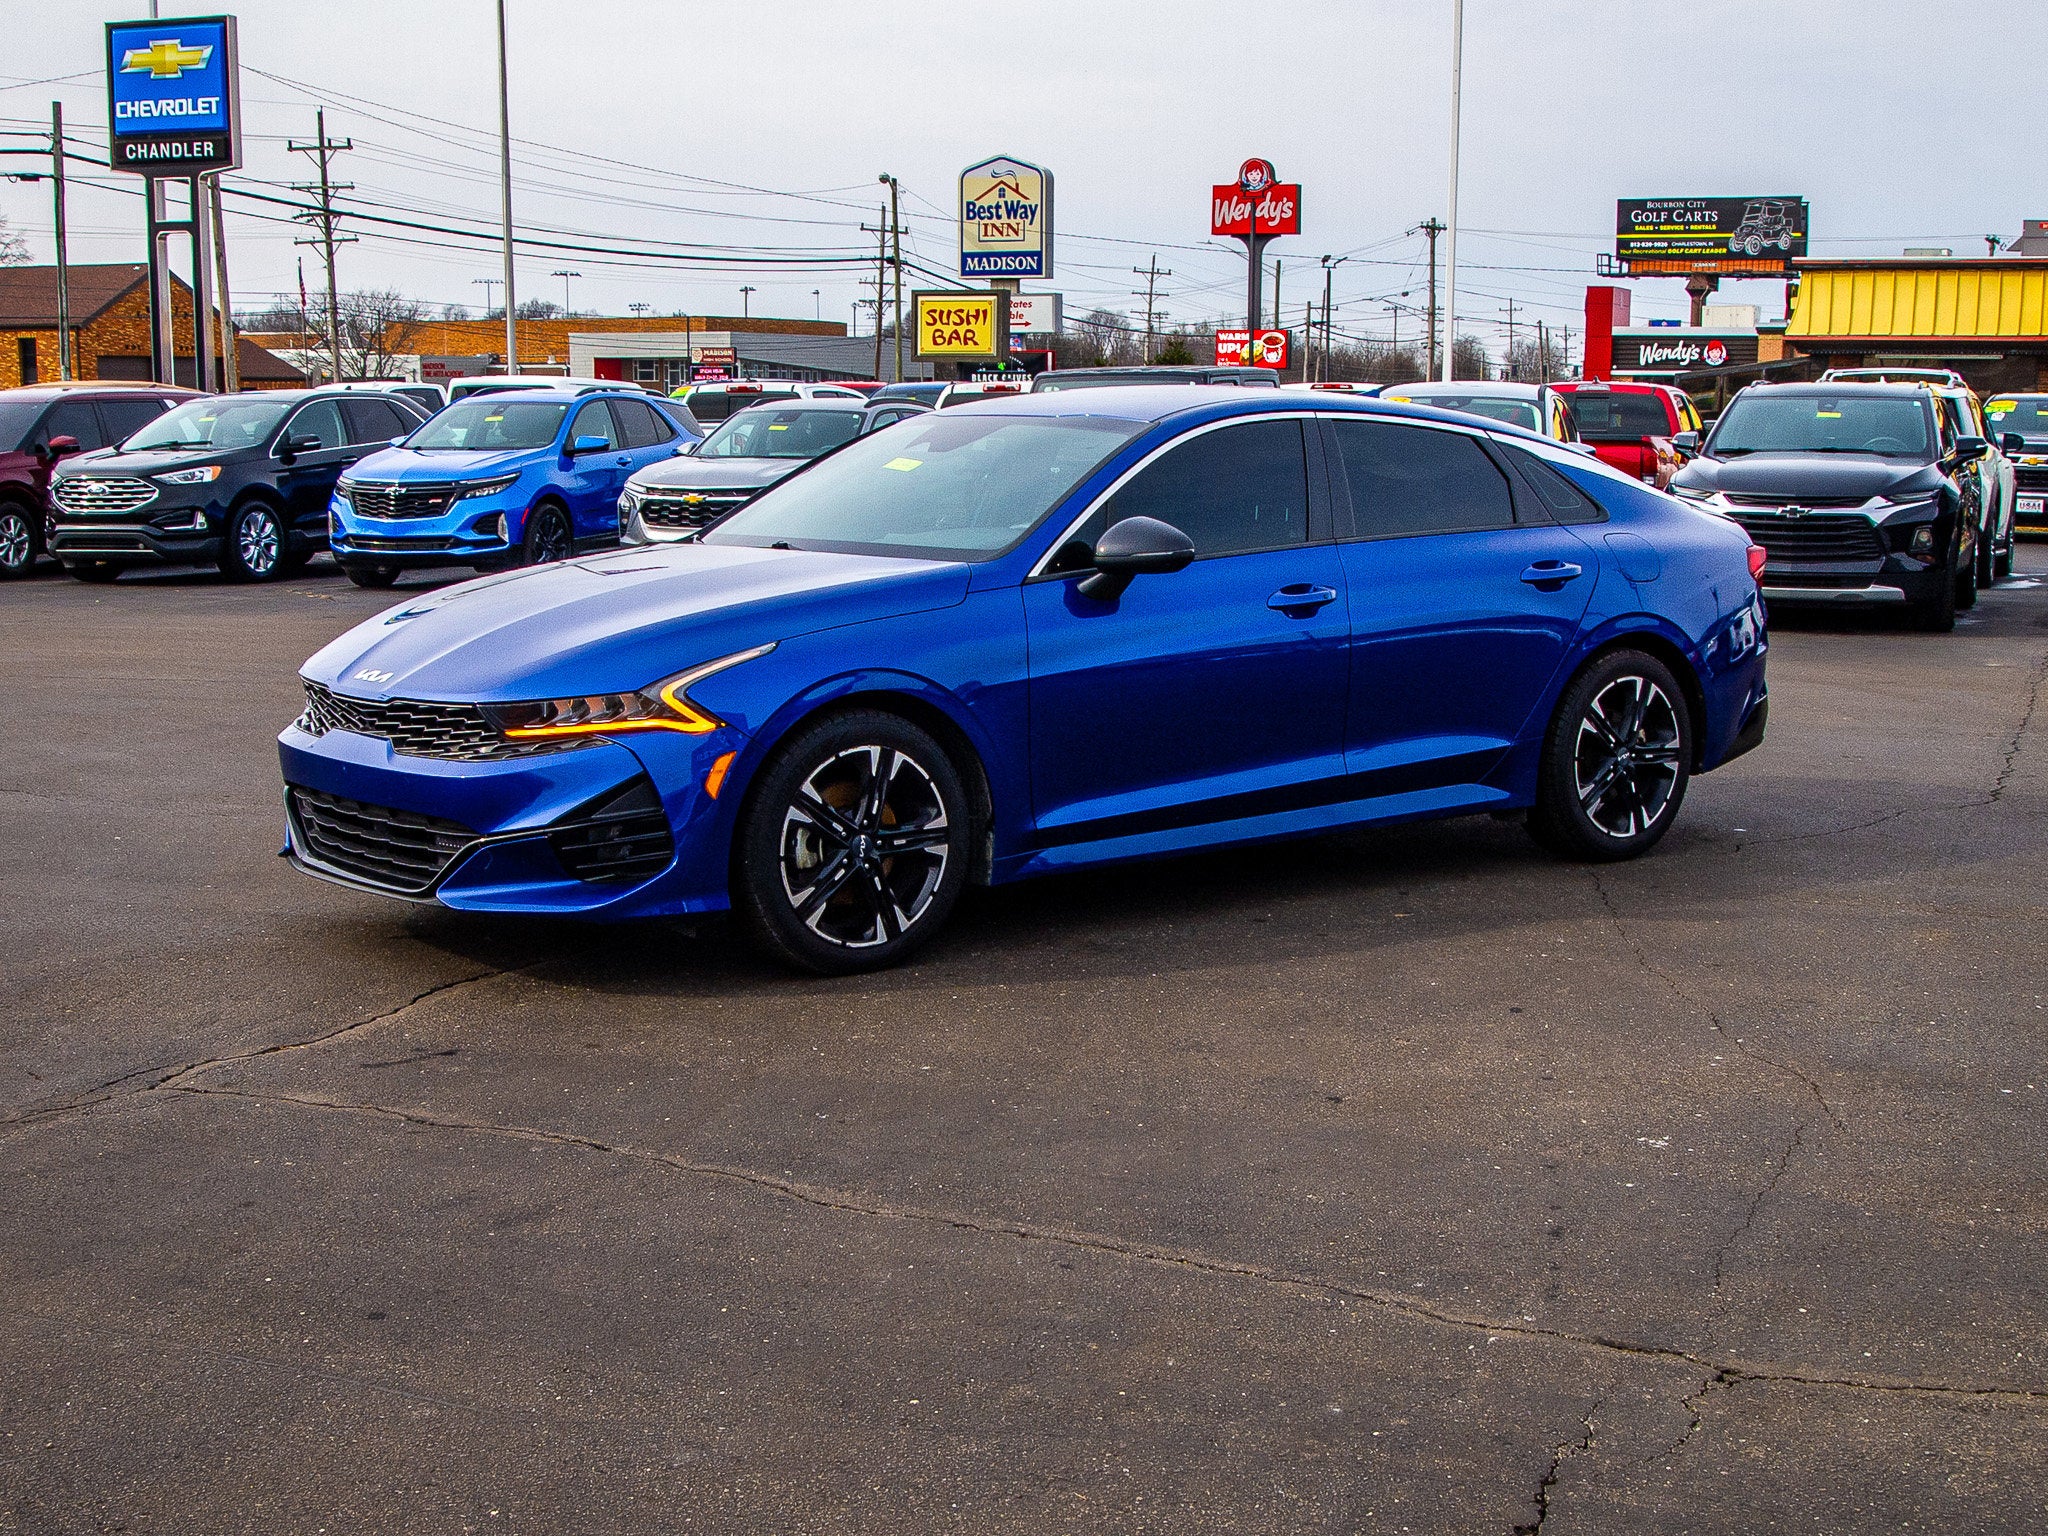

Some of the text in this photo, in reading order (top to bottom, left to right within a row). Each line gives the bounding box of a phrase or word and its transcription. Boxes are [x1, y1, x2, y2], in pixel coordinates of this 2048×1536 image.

[116, 97, 220, 118] CHEVROLET
[126, 141, 214, 159] CHANDLER
[965, 200, 1039, 226] Best Way
[1686, 200, 1707, 209] CITY
[1630, 209, 1718, 222] GOLF CARTS
[982, 222, 1020, 237] INN
[965, 256, 1039, 271] MADISON
[925, 308, 989, 326] SUSHI
[932, 328, 980, 346] BAR
[1640, 340, 1701, 366] Wendy's
